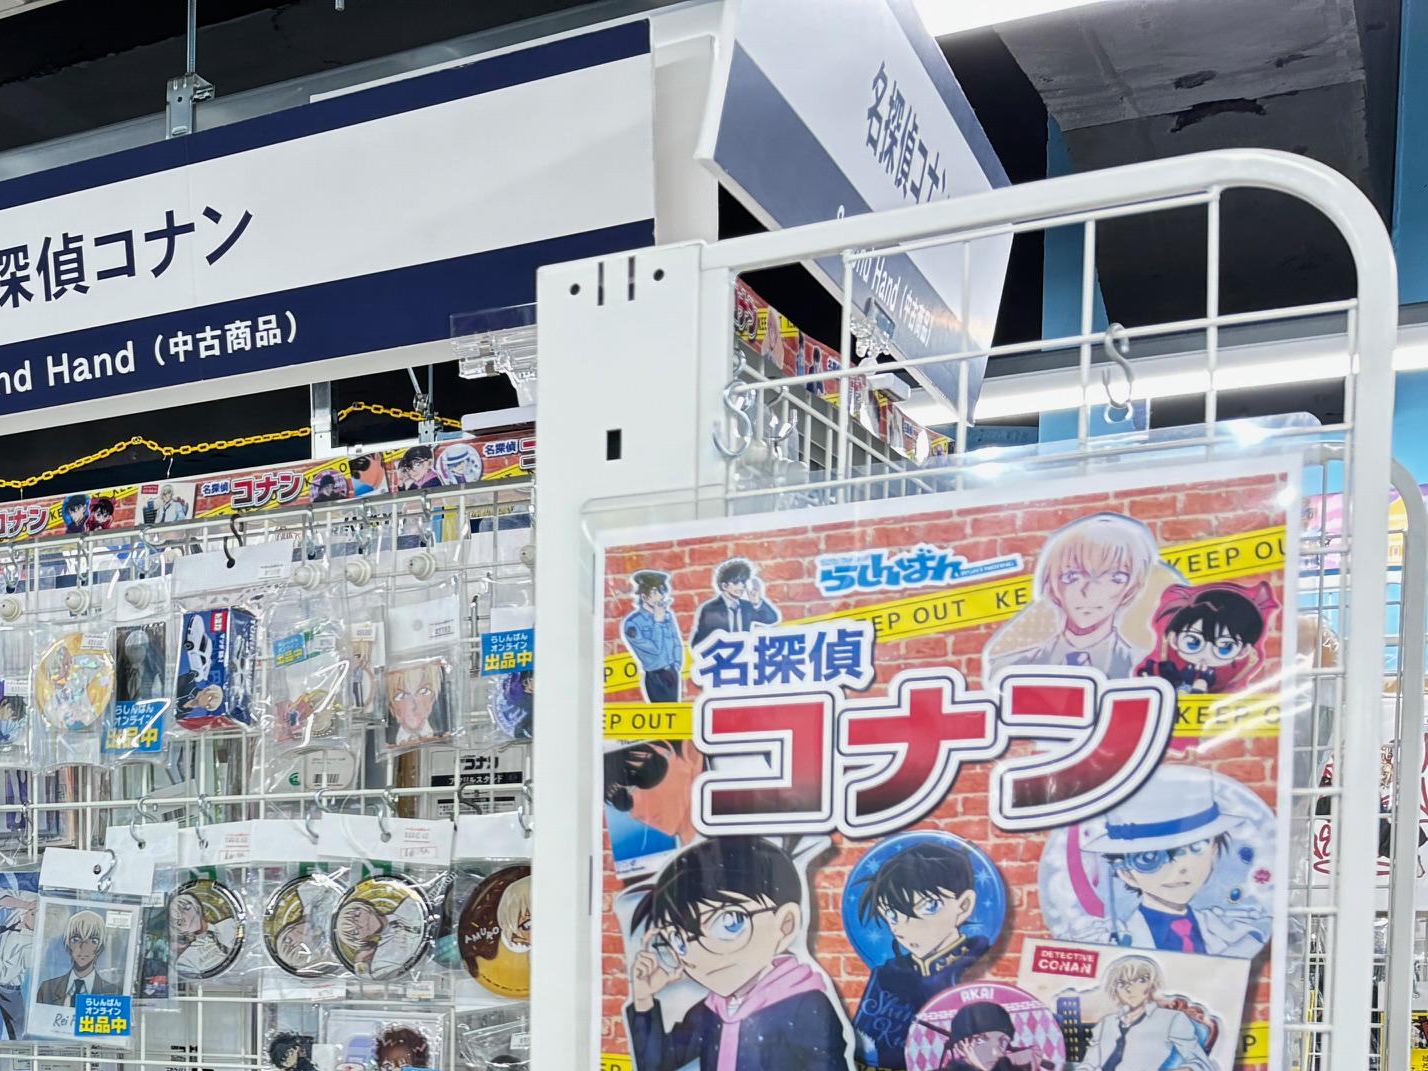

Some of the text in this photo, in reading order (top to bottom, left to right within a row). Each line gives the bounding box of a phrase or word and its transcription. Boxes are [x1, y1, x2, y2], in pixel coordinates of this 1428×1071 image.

[47, 342, 136, 388] Hand
[154, 309, 298, 369] （中古商品）
[485, 441, 518, 457] 名探偵
[201, 471, 302, 507] 名探偵 コナン
[820, 544, 967, 592] らしんばん
[913, 587, 1028, 627] OUT KE
[491, 633, 529, 644] らしんばん
[491, 641, 528, 651] オンライン
[276, 650, 303, 665] 出品中
[485, 650, 534, 671] 出品中
[699, 628, 864, 688] 名探偵
[632, 713, 677, 730] OUT
[700, 674, 1169, 832] コナン
[463, 926, 501, 944] AMURO
[1040, 949, 1095, 962] DETECTIVE
[1038, 959, 1092, 975] CONAN
[85, 997, 122, 1007] らしんばん
[960, 989, 995, 1003] AKAI
[85, 1006, 122, 1016] オンライン
[79, 1016, 128, 1034] 出品中
